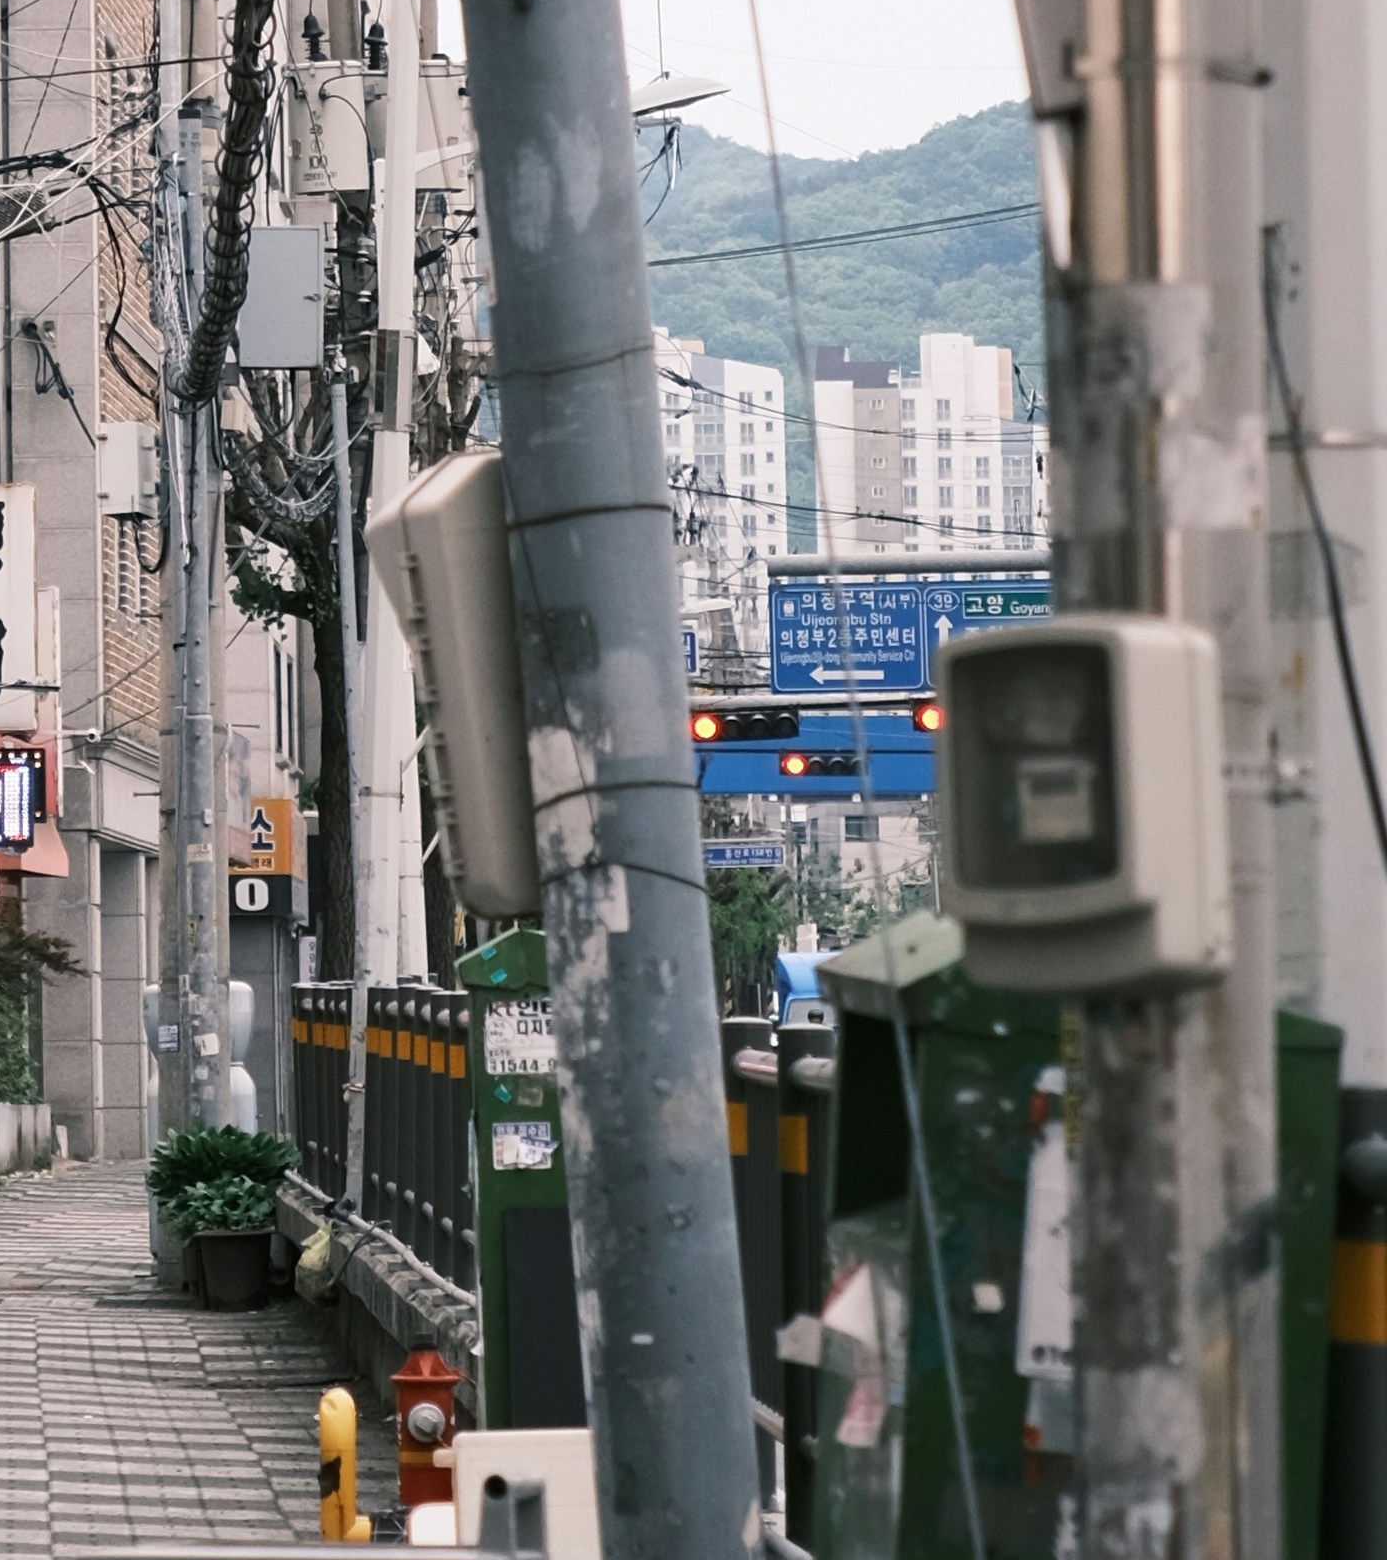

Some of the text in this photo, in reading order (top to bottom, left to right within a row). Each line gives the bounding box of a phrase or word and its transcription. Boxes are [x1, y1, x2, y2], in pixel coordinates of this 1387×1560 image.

[933, 593, 953, 609] 39
[965, 594, 1004, 615] 고양
[870, 612, 892, 625] Stn
[780, 626, 916, 649] 의정부2동주민센터
